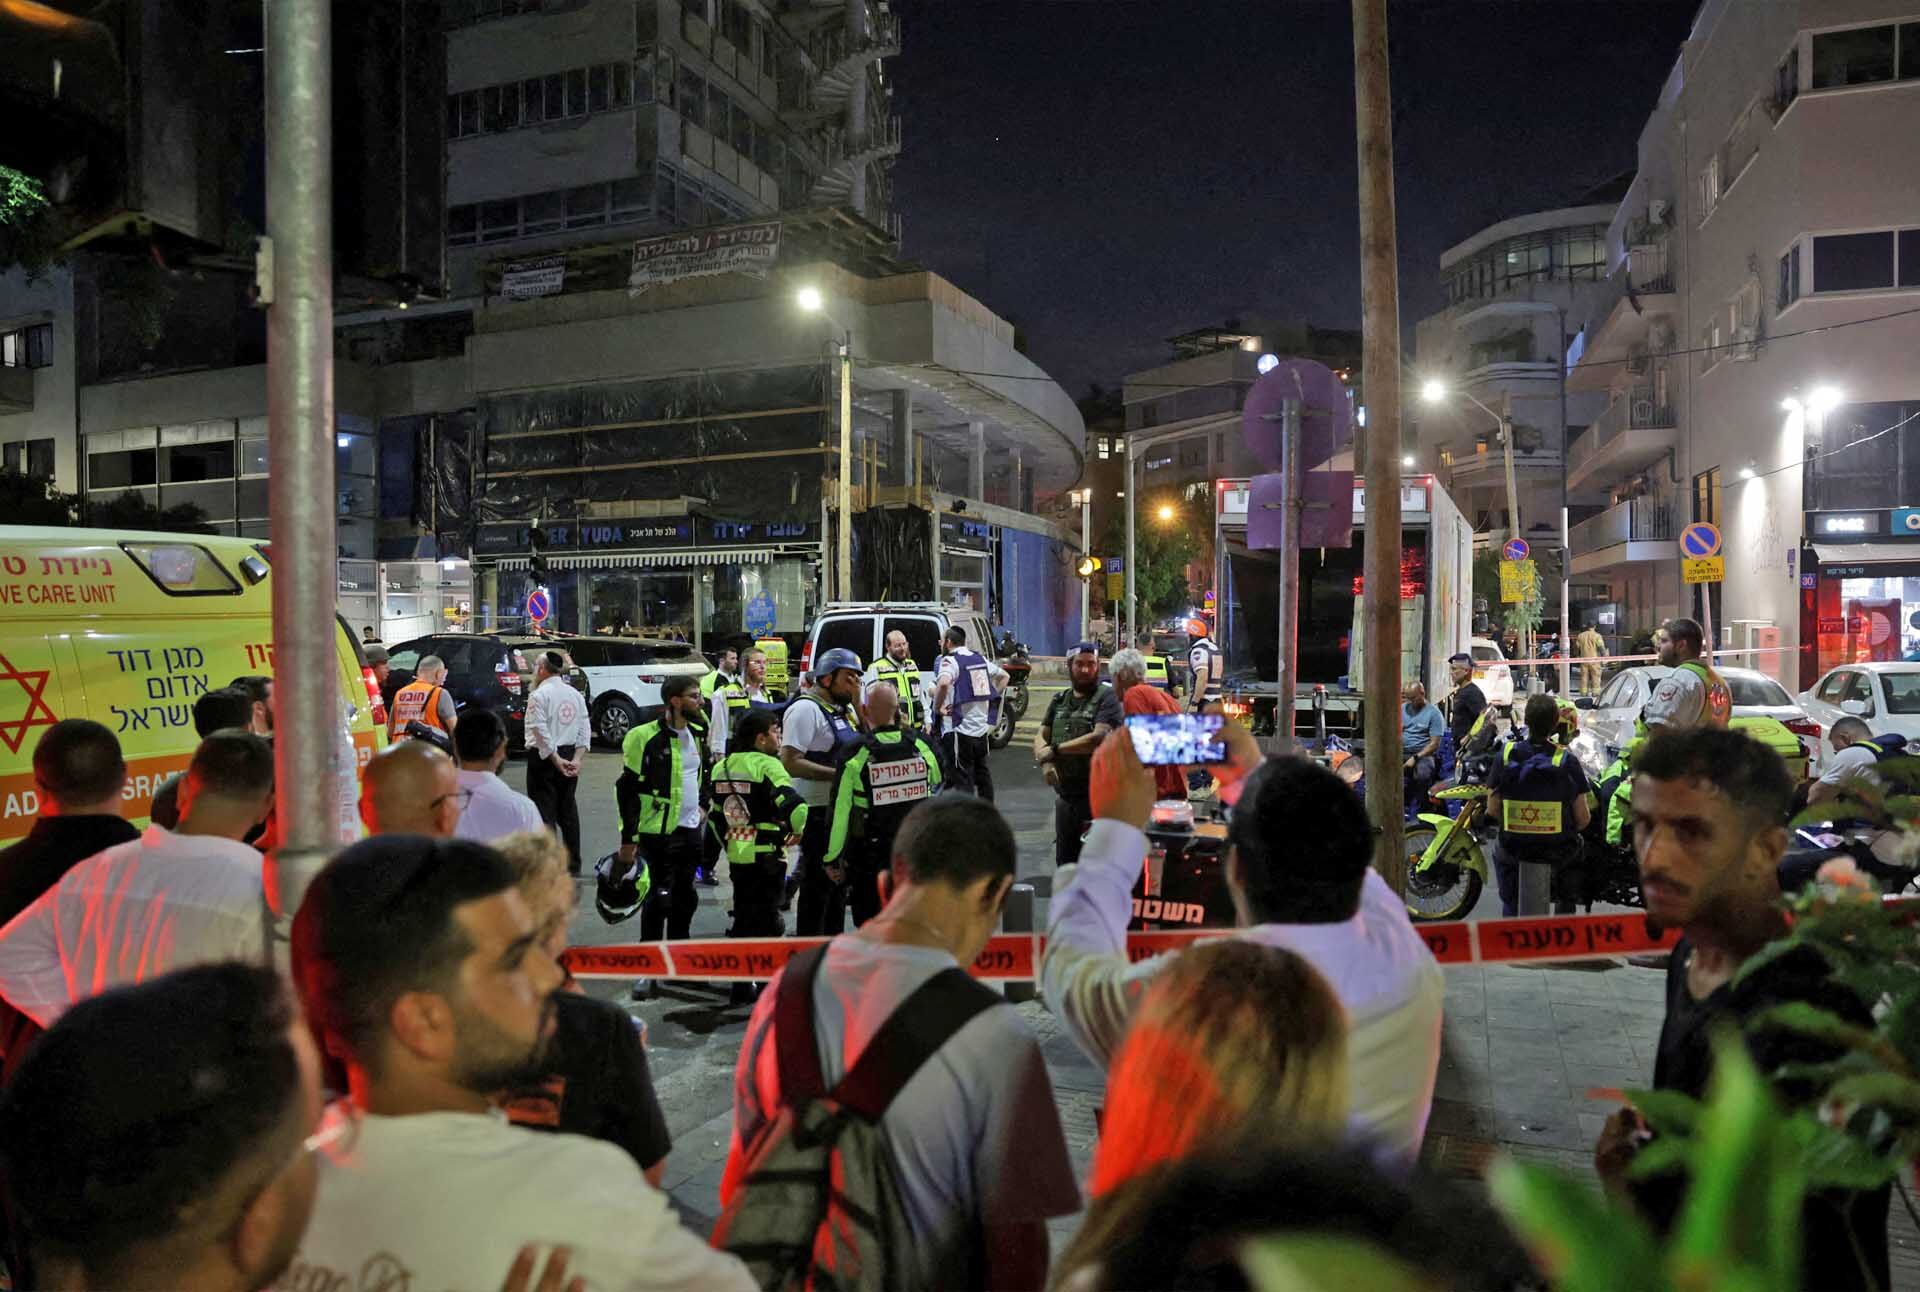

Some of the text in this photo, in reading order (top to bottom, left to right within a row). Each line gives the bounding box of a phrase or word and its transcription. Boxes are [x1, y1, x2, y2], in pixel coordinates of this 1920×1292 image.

[520, 527, 623, 545] SER YUDA
[629, 526, 677, 537] הלב של תל אביב
[39, 557, 113, 577] ניידת
[1801, 576, 1813, 586] 30
[27, 584, 77, 604] CARE
[80, 584, 116, 603] UNIT
[107, 647, 204, 674] מגן דוד
[147, 674, 209, 699] אדום
[399, 691, 425, 702] חובש
[871, 761, 926, 784] פראמדיק
[1132, 897, 1206, 926] משטר
[1498, 922, 1624, 950] אין מעבר
[682, 952, 774, 974] אין מעבר
